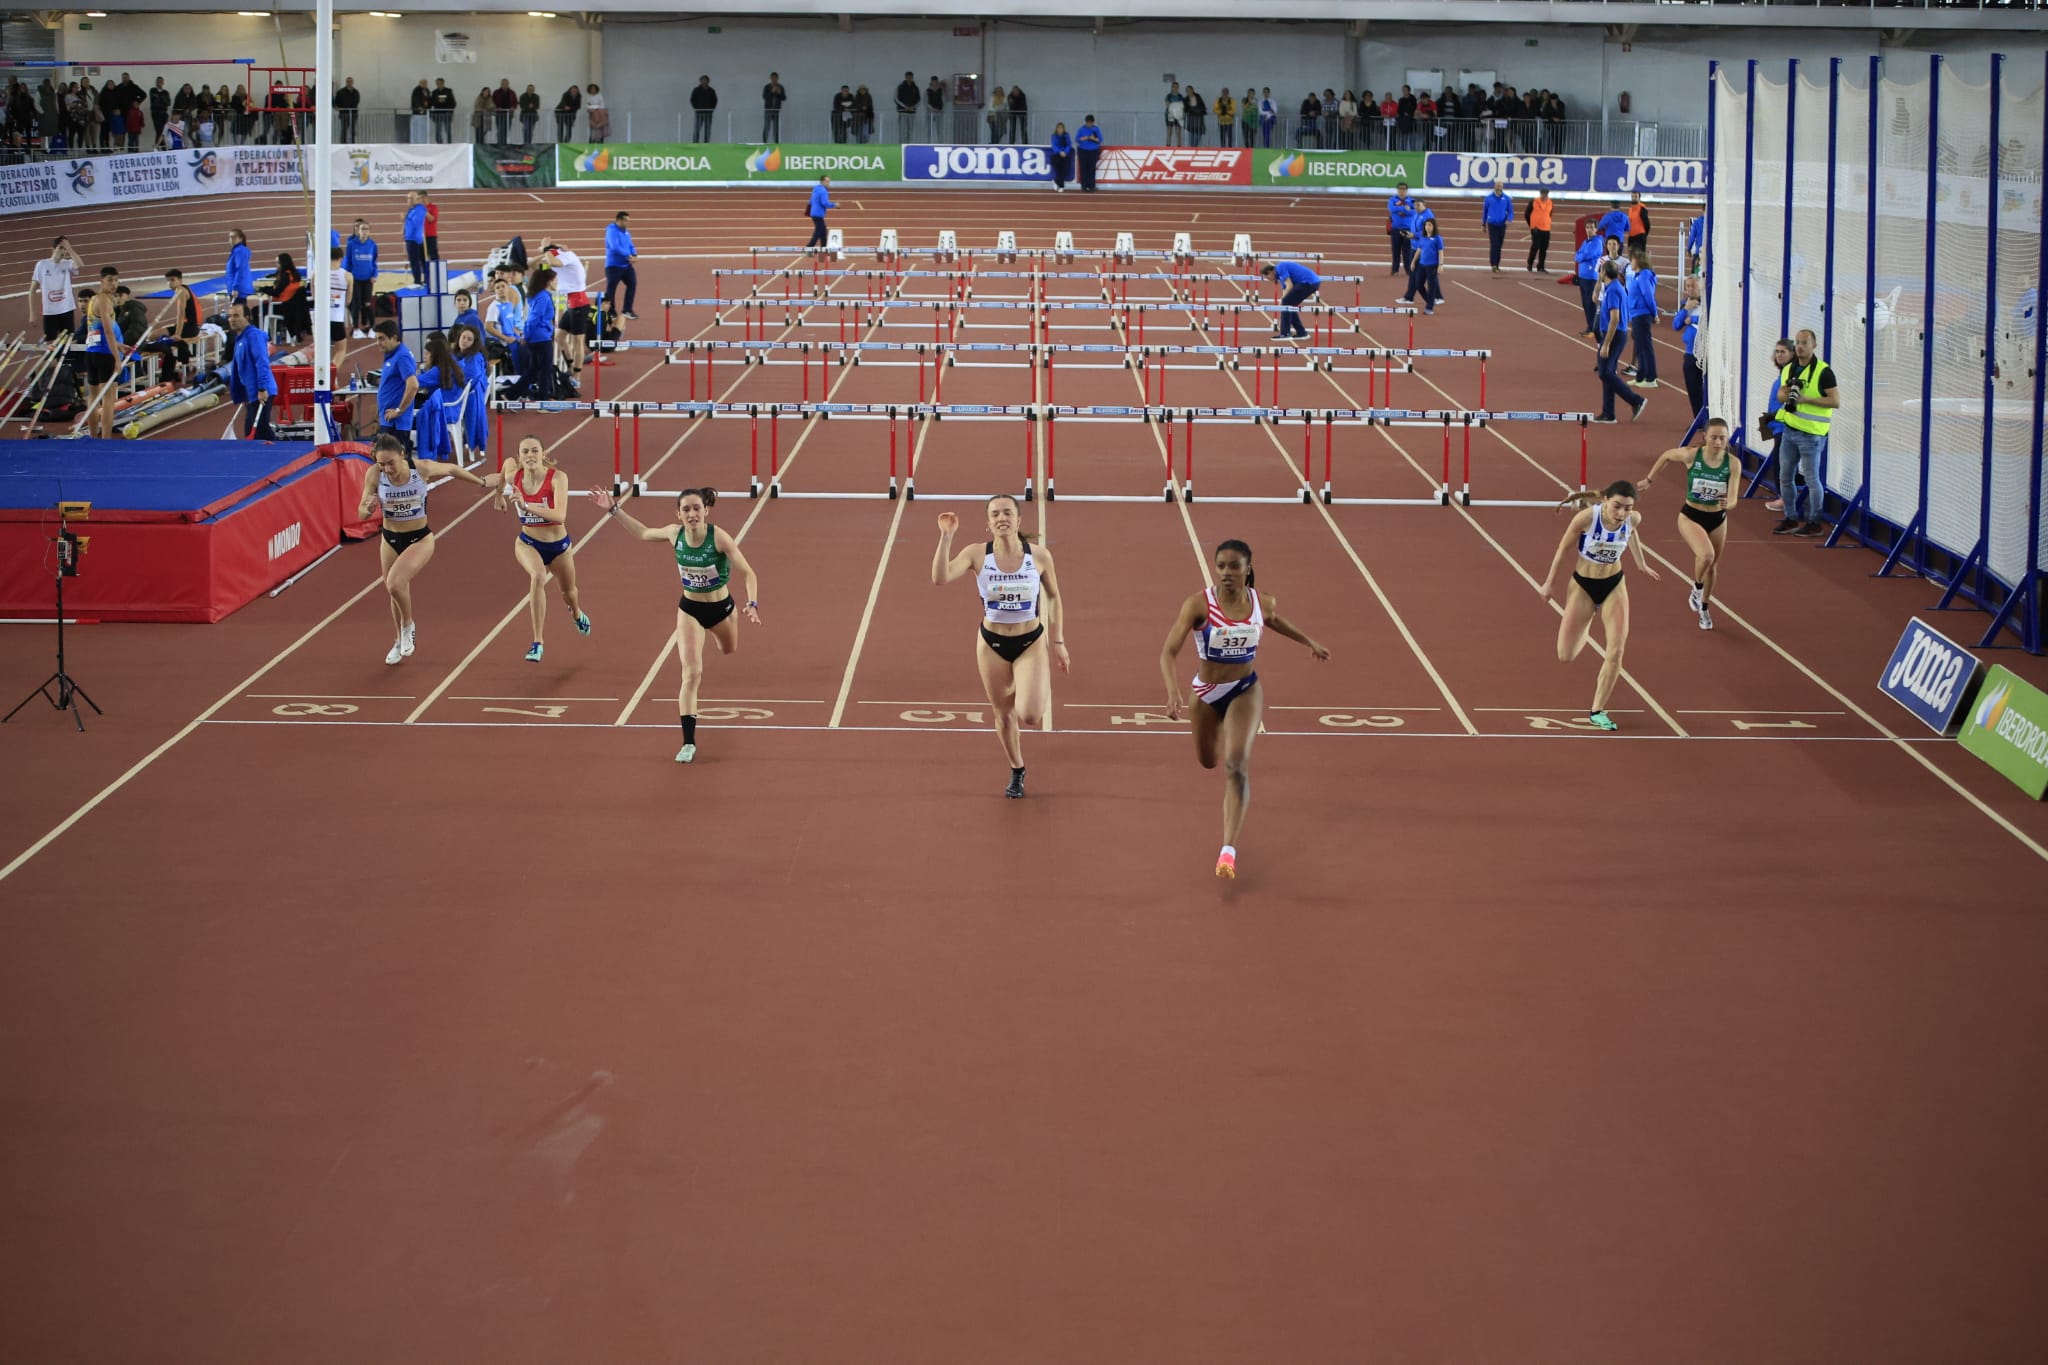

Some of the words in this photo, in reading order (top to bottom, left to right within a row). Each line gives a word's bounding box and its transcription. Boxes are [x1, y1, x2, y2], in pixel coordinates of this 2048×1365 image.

[234, 148, 288, 160] FEDERACIÓN
[1146, 149, 1242, 171] RFEA
[109, 154, 163, 169] FEDERACIÓN
[167, 154, 178, 165] DE
[374, 161, 433, 174] Ayuntamiento
[613, 155, 711, 171] IBERDROLA
[784, 155, 885, 171] IBERDROLA
[45, 165, 56, 176] DE
[112, 166, 179, 183] ATLETISMO
[1308, 161, 1407, 178] IBERDROLA
[1617, 157, 1708, 192] Jom
[374, 174, 384, 184] de
[387, 173, 433, 184] Salamanca
[1139, 171, 1231, 182] ATLETISMO
[0, 177, 57, 195] TLETISMO
[123, 183, 155, 195] CASTILLA
[392, 503, 412, 512] 380
[274, 521, 301, 561] MONDO
[1596, 549, 1617, 558] 428
[999, 593, 1021, 602] 381
[1222, 636, 1248, 648] 337
[271, 702, 360, 717] 8
[482, 705, 569, 718] 7
[899, 709, 986, 723] 5
[1318, 713, 1405, 728] 3
[1730, 719, 1817, 730] 1
